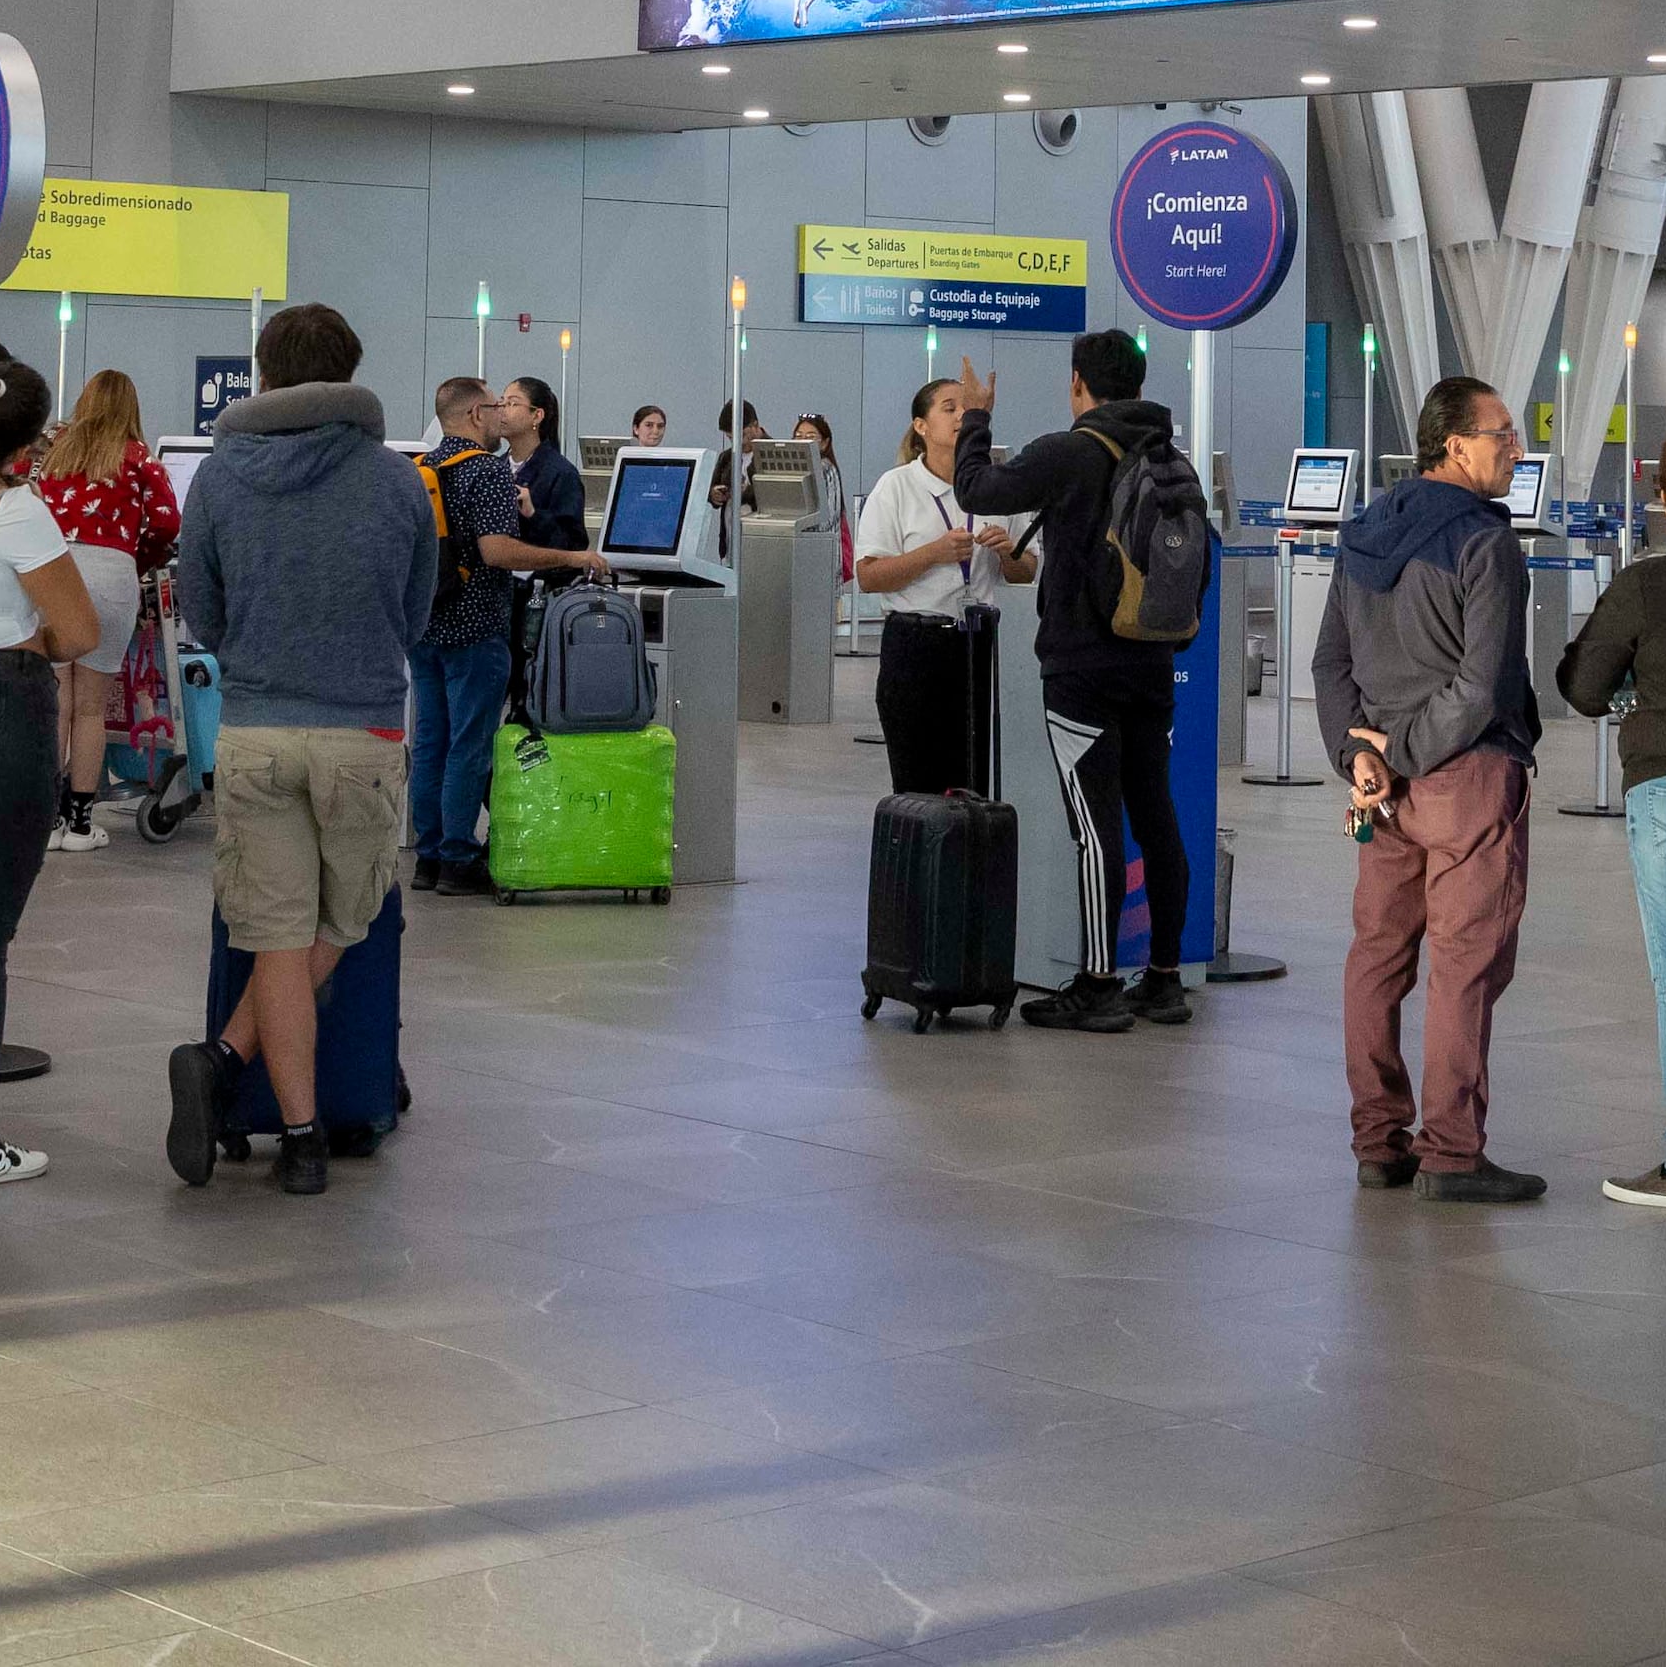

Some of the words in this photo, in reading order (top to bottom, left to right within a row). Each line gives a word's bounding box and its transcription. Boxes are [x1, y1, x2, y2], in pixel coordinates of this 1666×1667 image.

[1181, 149, 1228, 161] LATAM
[50, 189, 193, 212] Sobredimensionado
[1147, 191, 1248, 220] ¡Comienza
[50, 211, 106, 229] Baggage
[1171, 223, 1222, 251] Aquí!
[867, 238, 906, 253] Salidas
[930, 245, 960, 256] Puertas
[962, 247, 971, 257] de
[974, 247, 1013, 260] Embarque
[867, 256, 919, 270] Departures
[930, 259, 960, 270] Boarding
[961, 260, 980, 270] Gates
[1165, 264, 1194, 278] Start
[1196, 264, 1227, 277] Here!
[864, 285, 898, 300] Baños
[929, 288, 977, 304] Custodia
[979, 291, 993, 305] de
[995, 293, 1040, 308] Equipaje
[865, 303, 895, 316] Toilets
[929, 307, 969, 321] Baggage
[971, 308, 1007, 322] Storage
